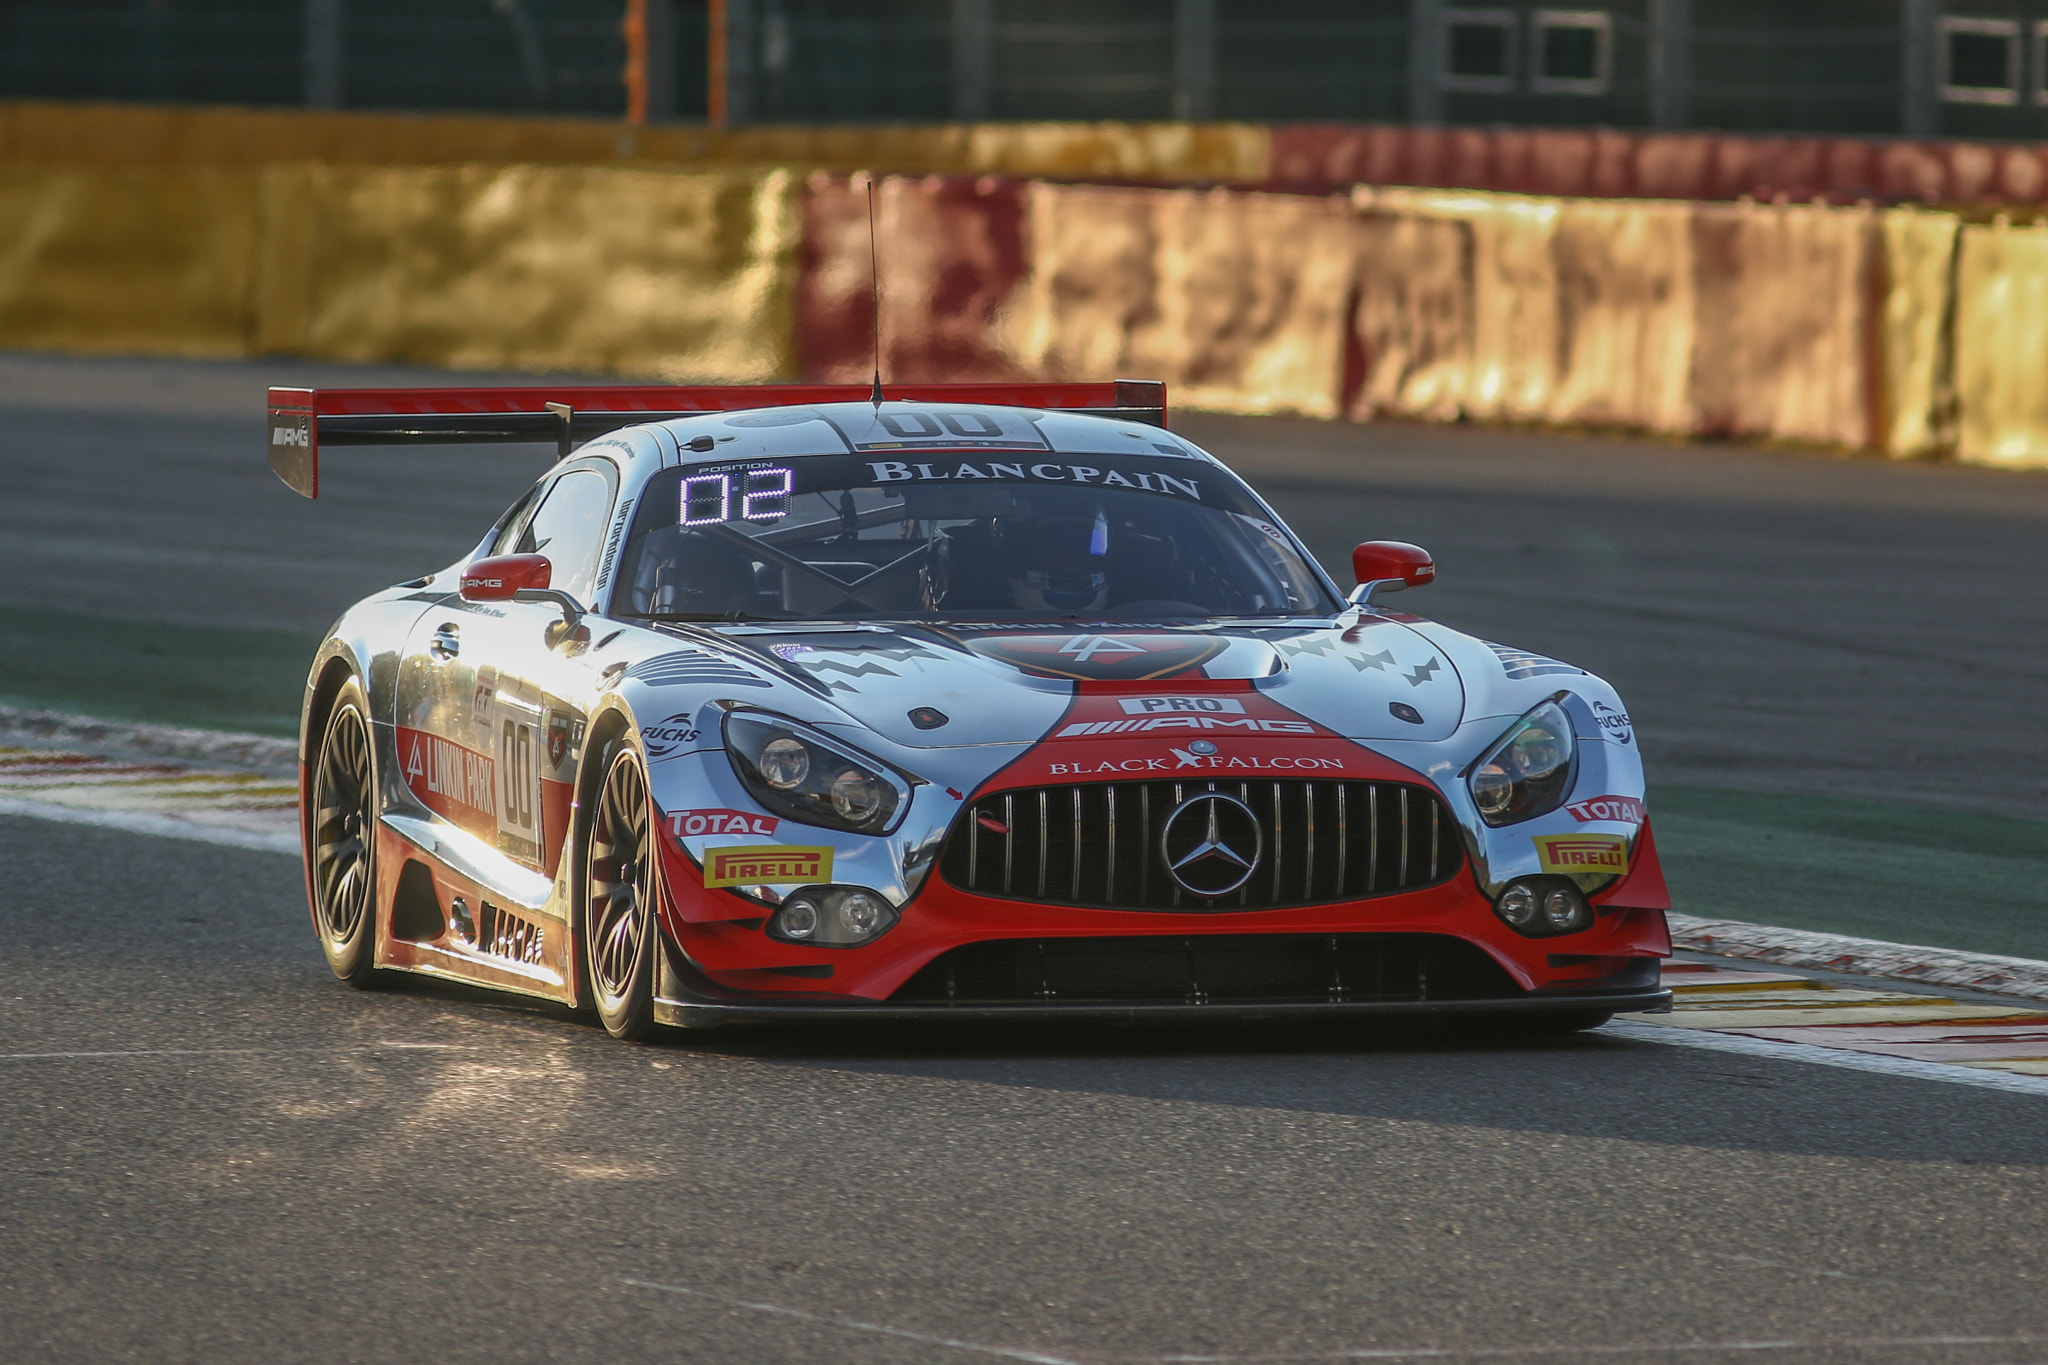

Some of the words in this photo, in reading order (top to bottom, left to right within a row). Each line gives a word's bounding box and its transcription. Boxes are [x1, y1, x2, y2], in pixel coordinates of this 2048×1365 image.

[875, 412, 1003, 437] 00
[281, 427, 309, 447] AMG
[698, 462, 773, 474] POSITION
[865, 461, 1201, 500] BLANCPAIN
[680, 468, 793, 526] 02
[465, 579, 503, 588] AMG
[1139, 698, 1224, 712] PRO
[1141, 716, 1316, 734] AMG
[1594, 713, 1632, 729] FUCHS
[640, 727, 702, 742] FUCHS
[426, 736, 466, 804] LINKIN
[466, 751, 495, 817] PARK
[502, 718, 532, 830] 00
[1049, 758, 1171, 775] BLACK
[1207, 756, 1345, 771] FALCON
[667, 811, 773, 836] TOTAL
[1565, 801, 1643, 824] TOTAL
[1545, 841, 1622, 867] PIRELLI
[715, 852, 821, 880] PIRELLI
